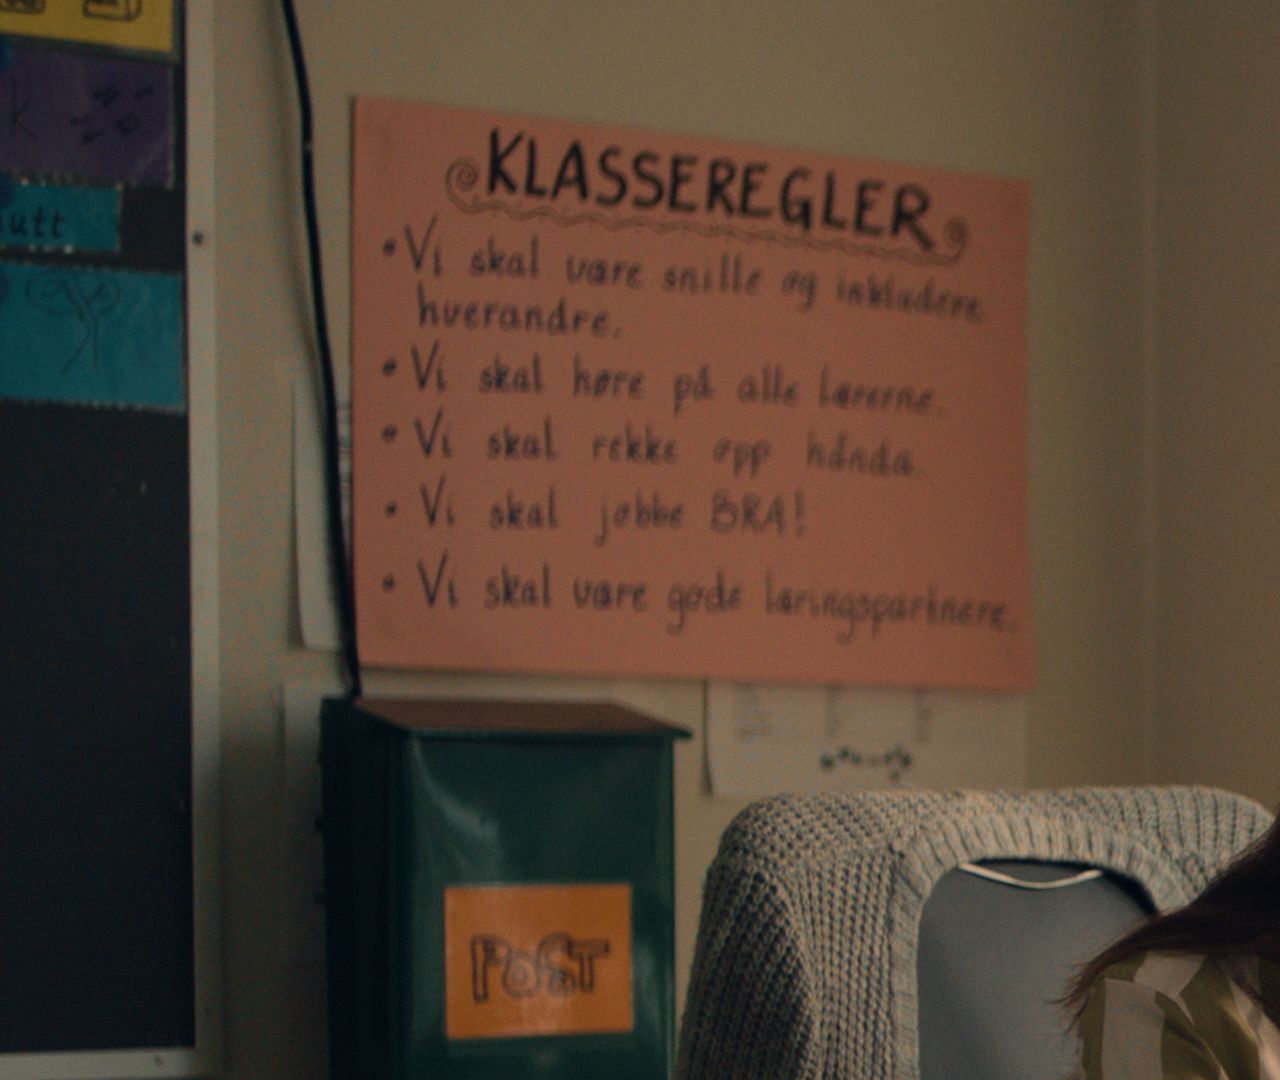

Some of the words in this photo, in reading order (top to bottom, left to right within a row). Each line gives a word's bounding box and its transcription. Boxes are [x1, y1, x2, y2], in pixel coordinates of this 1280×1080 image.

[0, 204, 65, 240] utt
[487, 127, 936, 252] KLASSEREGLER
[404, 215, 443, 279] Vi
[469, 233, 540, 279] skal
[661, 253, 763, 295] snille
[781, 269, 818, 314] og
[836, 272, 983, 324] inkludere
[410, 340, 447, 393] Vi
[478, 351, 544, 395] skal
[572, 354, 646, 399] høre
[737, 363, 798, 406] alle
[414, 407, 452, 460] Vi
[486, 415, 557, 461] skal
[592, 421, 677, 465] rekke
[711, 438, 773, 480] opp
[419, 473, 457, 529] Vi
[489, 482, 558, 530] skal
[710, 488, 806, 538] BRA!
[416, 550, 459, 609] Vi
[484, 562, 553, 610] skal
[665, 567, 743, 636] gode
